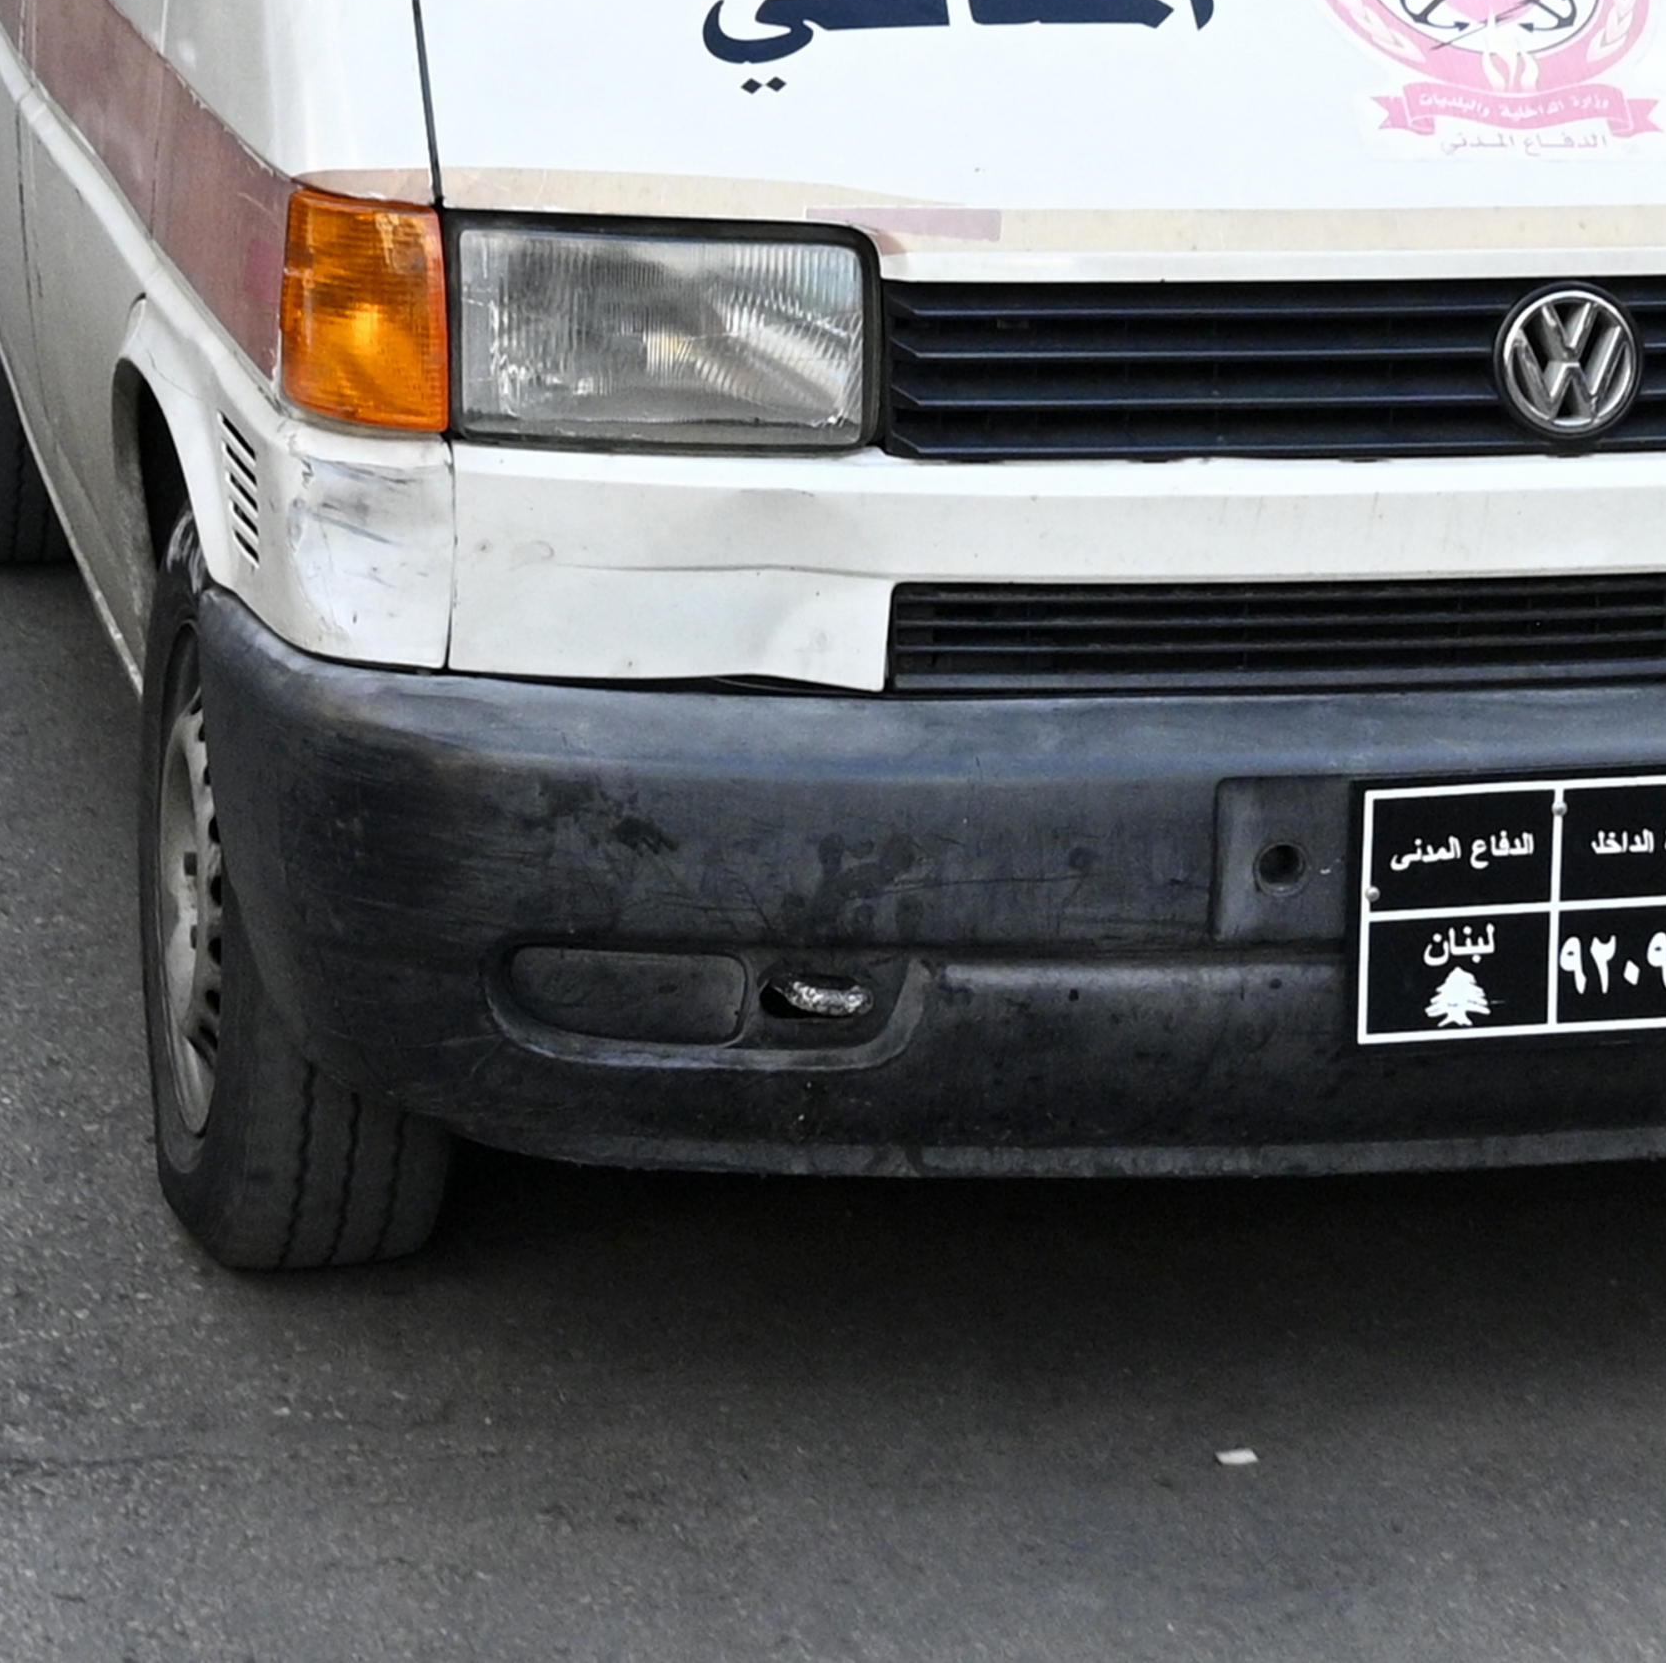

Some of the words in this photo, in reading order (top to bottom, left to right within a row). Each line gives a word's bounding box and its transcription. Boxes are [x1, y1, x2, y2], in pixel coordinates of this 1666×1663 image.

[1522, 133, 1608, 157] الدفاع
[1469, 829, 1534, 869] الدفاع
[1423, 922, 1496, 965] لبنان
